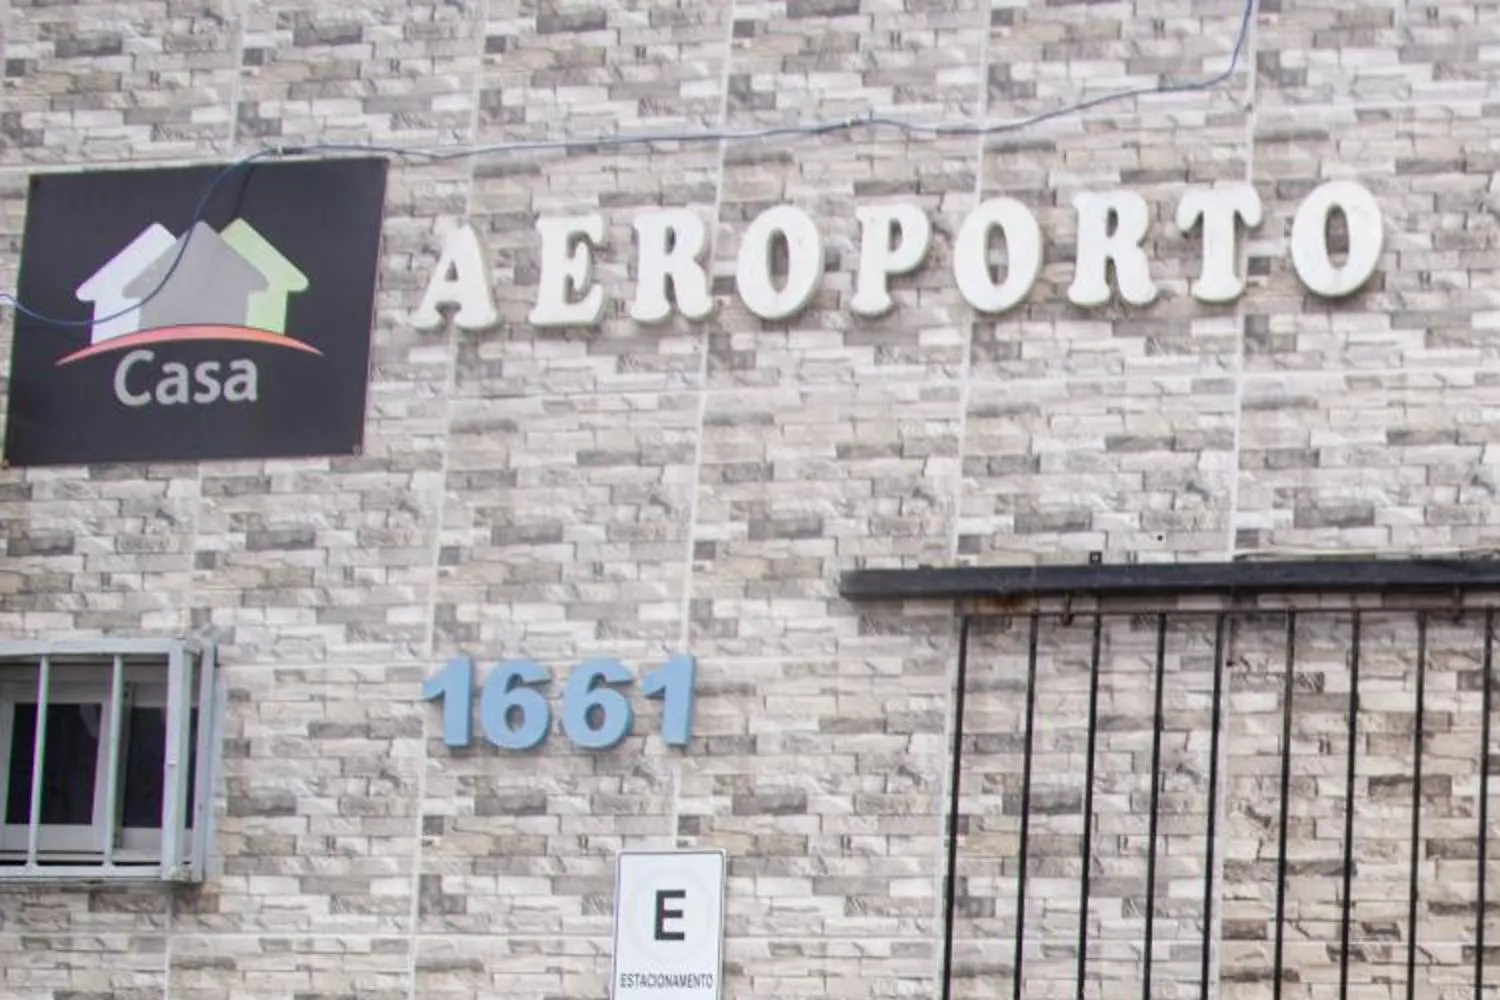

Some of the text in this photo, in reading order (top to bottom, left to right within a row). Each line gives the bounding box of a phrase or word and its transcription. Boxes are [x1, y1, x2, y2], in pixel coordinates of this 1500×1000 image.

[409, 181, 1383, 329] AEROPORTO
[114, 349, 258, 406] Casa
[422, 653, 696, 750] 1661
[654, 889, 686, 941] E
[619, 972, 713, 990] ESTACIONAMENTO
